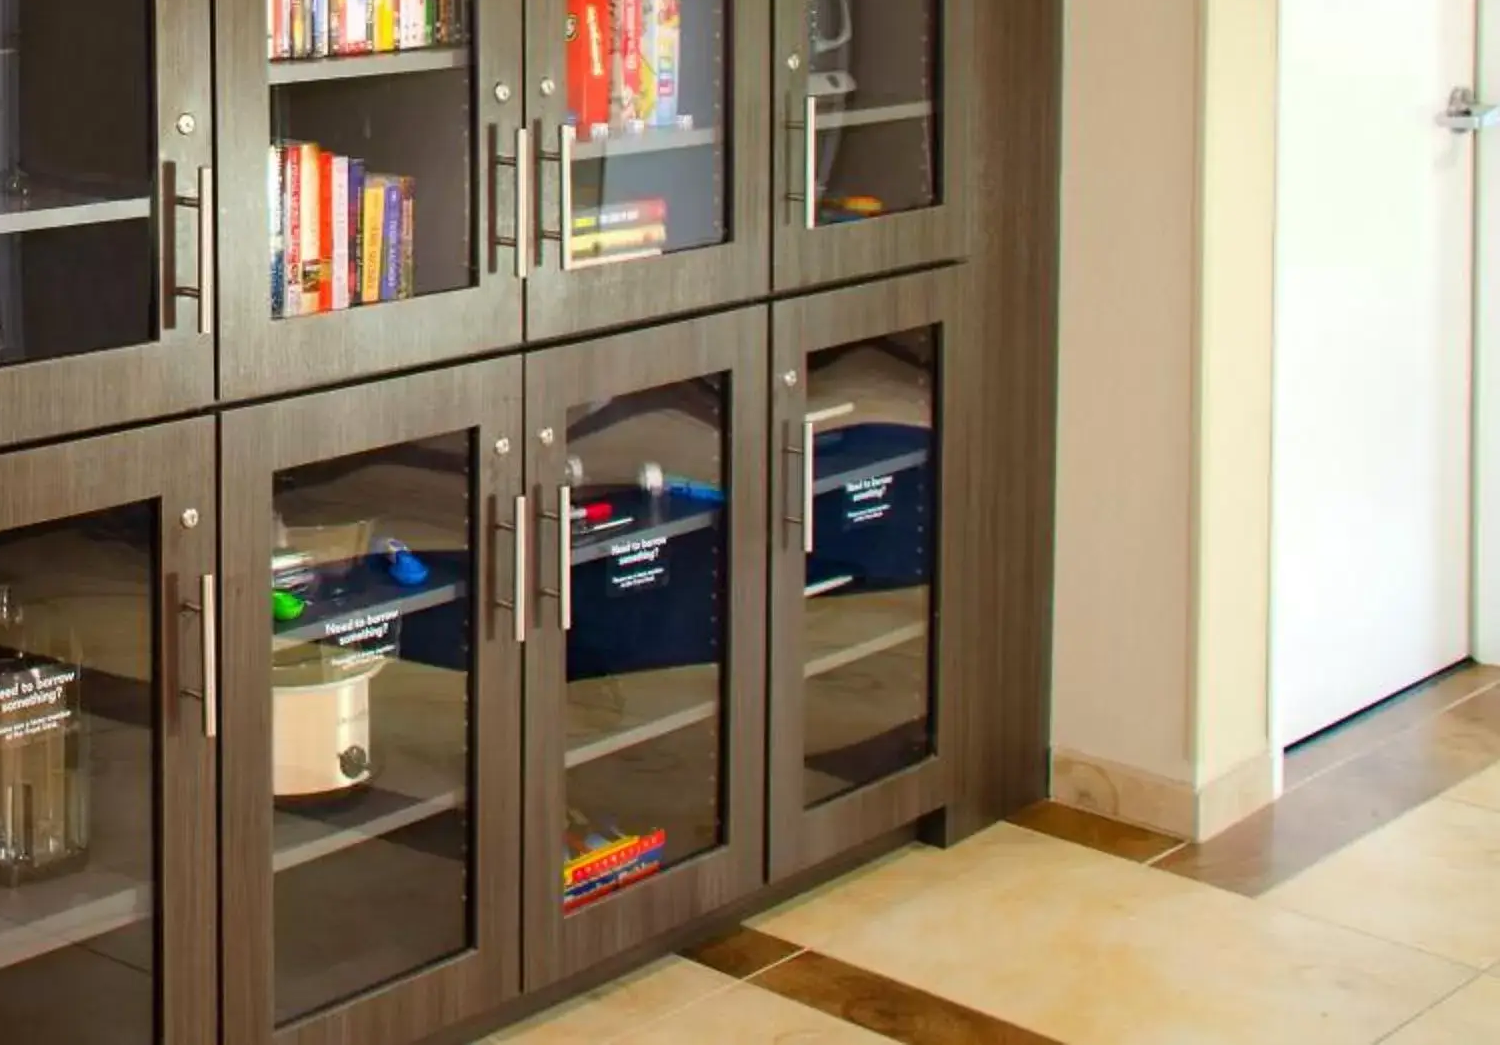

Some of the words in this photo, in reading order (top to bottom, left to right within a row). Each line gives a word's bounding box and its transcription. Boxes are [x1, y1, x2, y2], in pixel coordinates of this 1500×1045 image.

[325, 619, 354, 635] Need
[21, 682, 34, 694] to
[35, 670, 75, 690] borrow
[2, 686, 63, 713] something?
